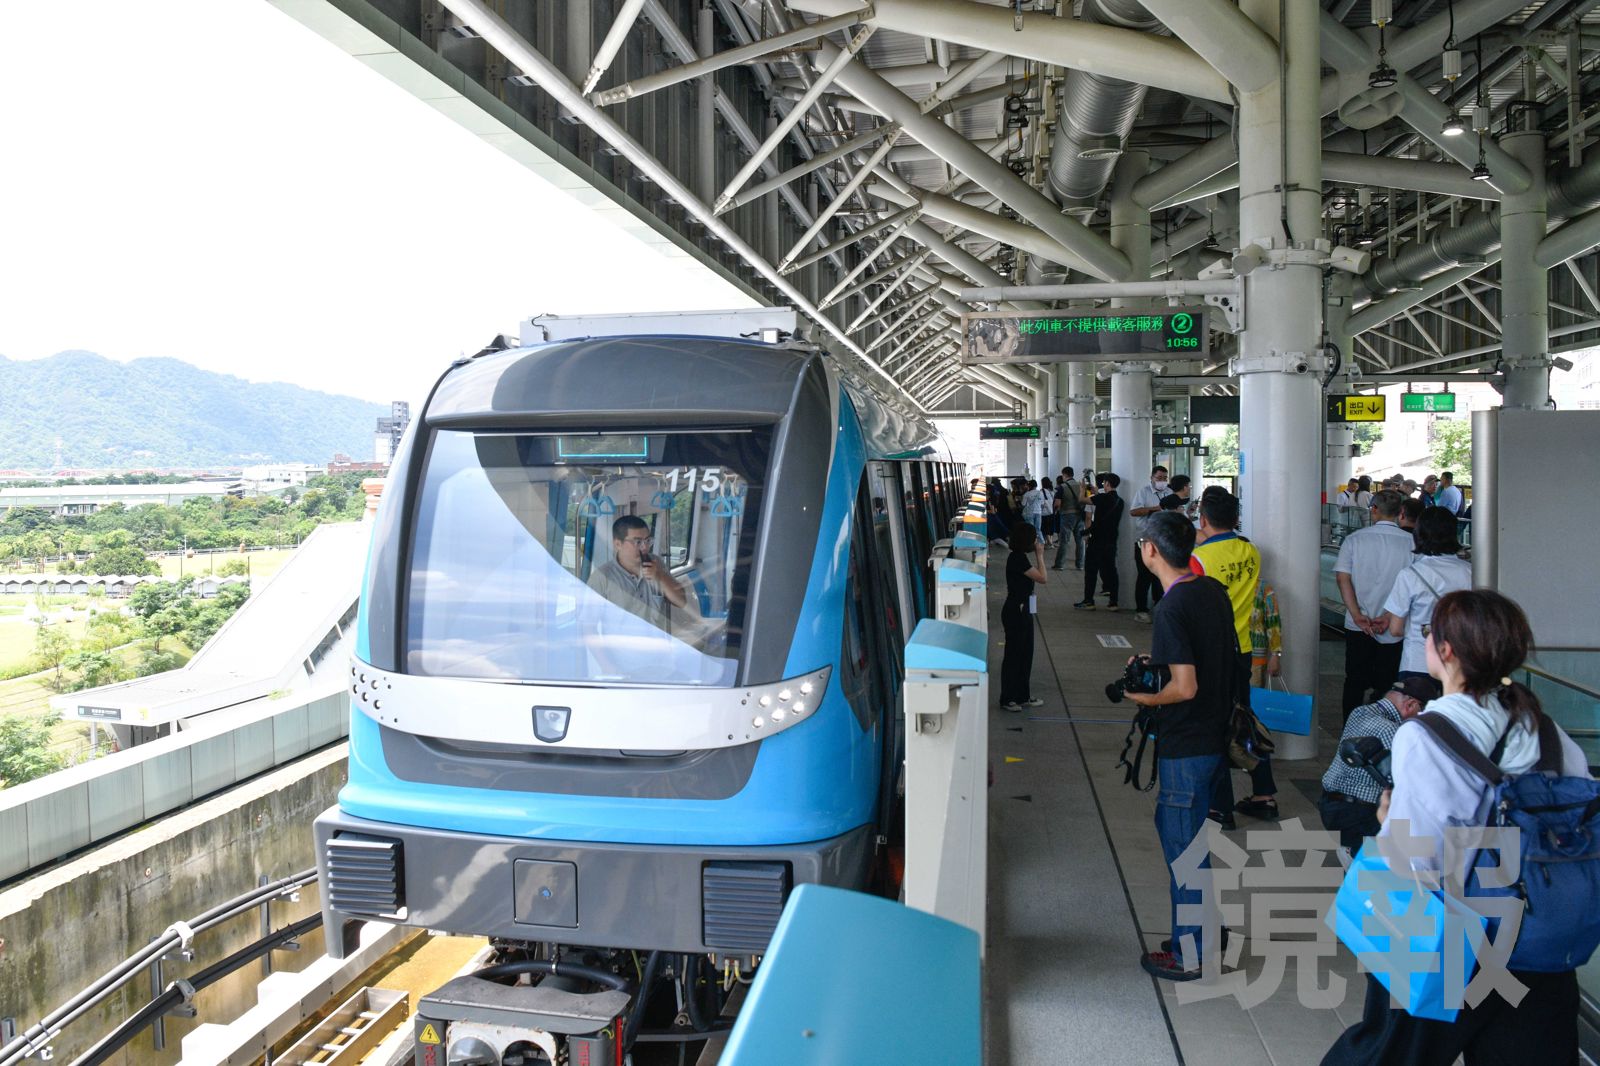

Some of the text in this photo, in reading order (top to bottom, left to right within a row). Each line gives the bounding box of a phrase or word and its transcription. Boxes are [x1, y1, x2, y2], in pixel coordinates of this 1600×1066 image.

[1167, 337, 1198, 348] 10:56
[1335, 401, 1343, 416] 1
[1349, 401, 1364, 409] 出口
[665, 468, 720, 492] 115
